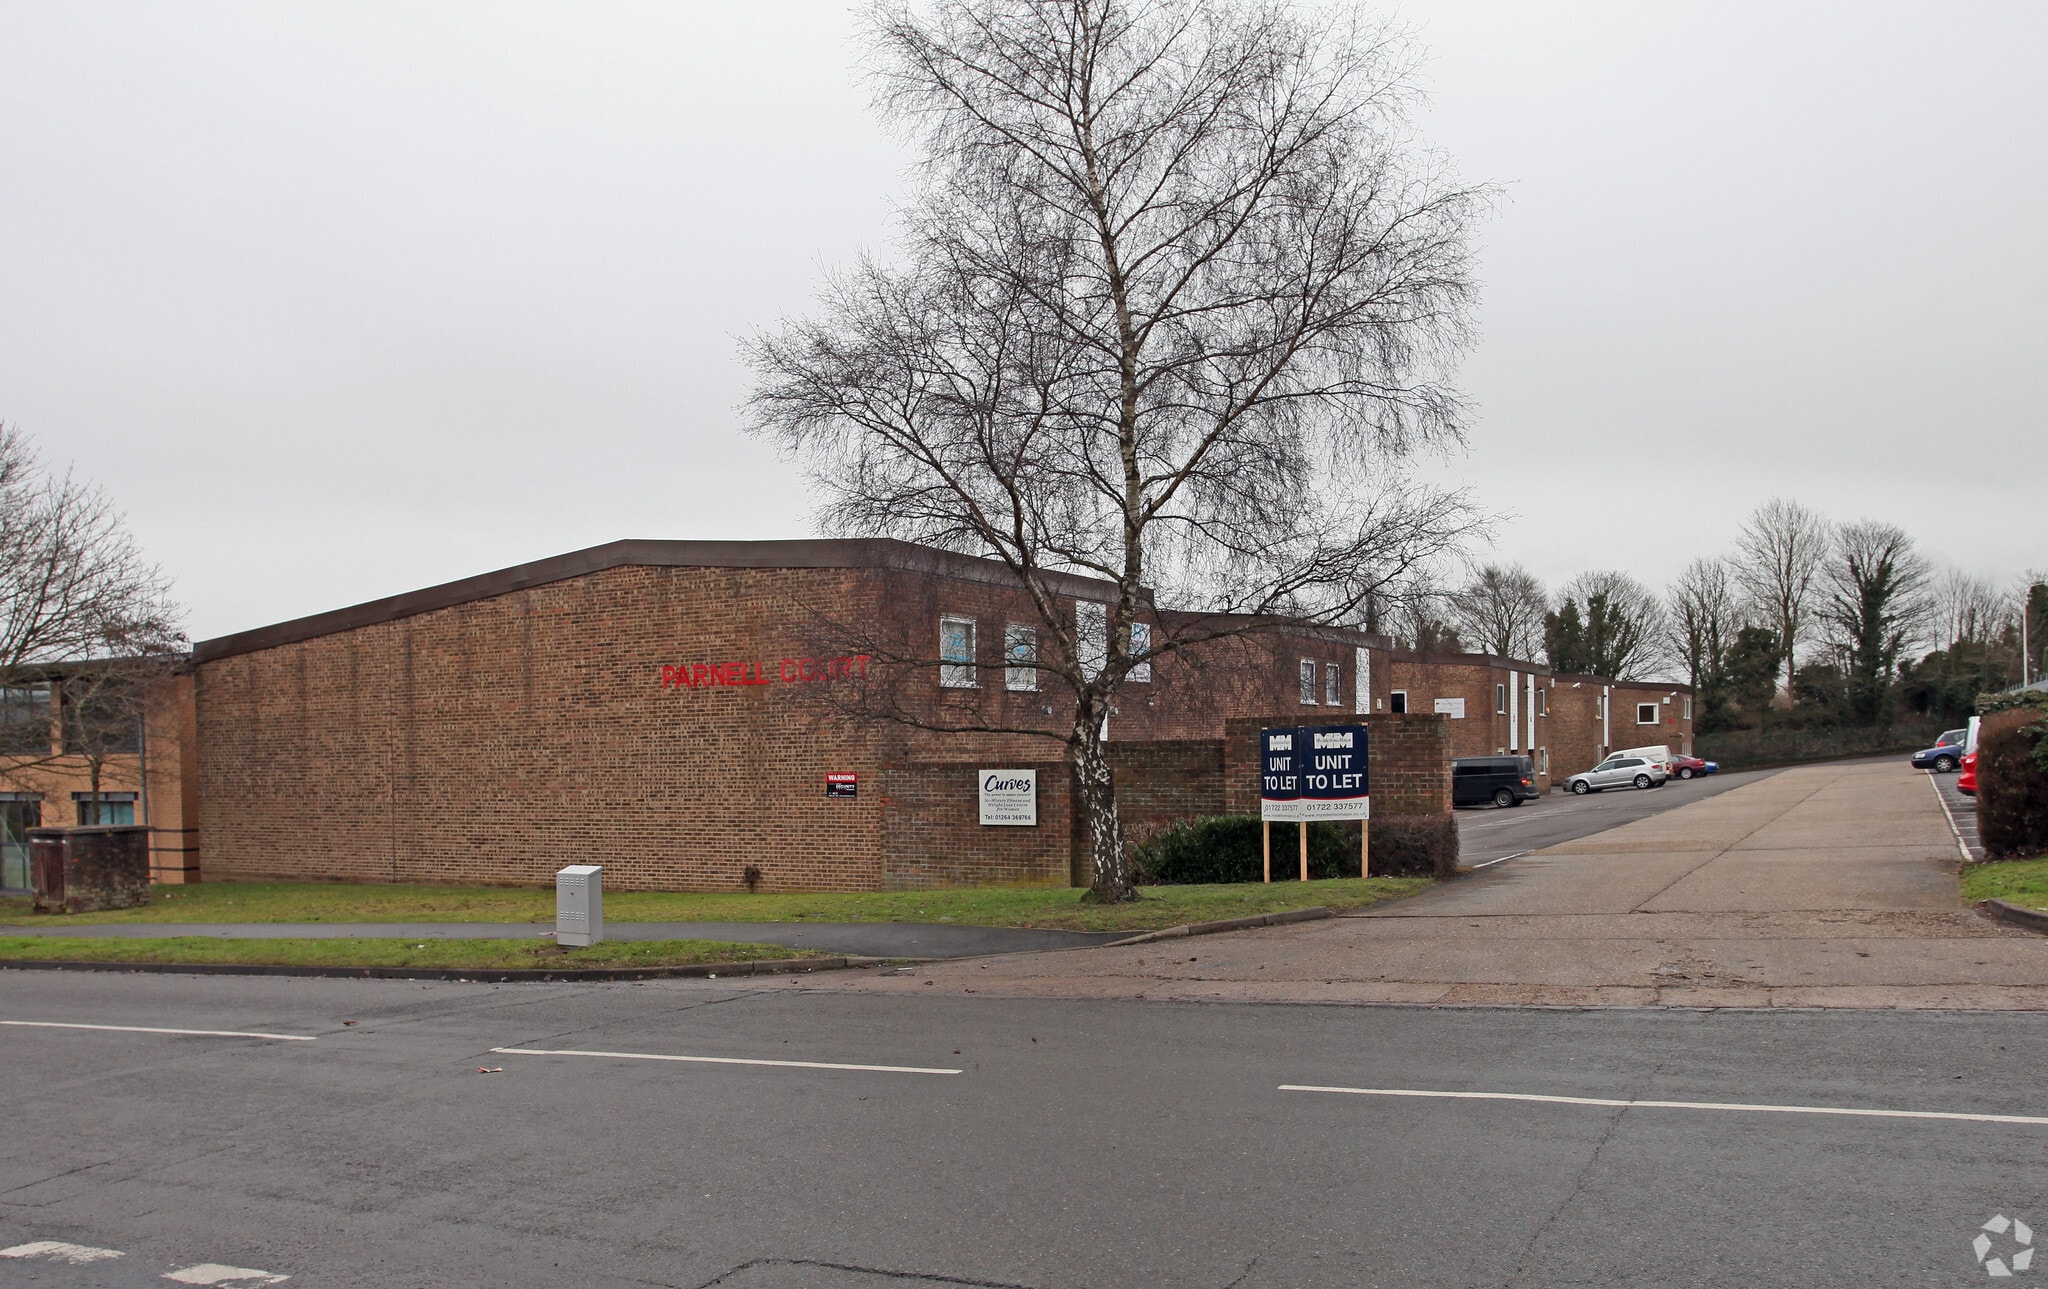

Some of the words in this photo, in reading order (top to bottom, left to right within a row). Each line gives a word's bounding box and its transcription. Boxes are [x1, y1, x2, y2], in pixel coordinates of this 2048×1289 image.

[661, 661, 770, 689] PARNELL
[1269, 757, 1292, 771] UNIT
[1315, 755, 1352, 770] UNIT
[984, 775, 1031, 792] Curves
[1263, 776, 1278, 790] TO
[1280, 776, 1298, 790] LET
[1306, 774, 1328, 790] TO
[1332, 773, 1363, 789] LET
[1306, 803, 1331, 811] 01722
[1333, 802, 1363, 810] 337577
